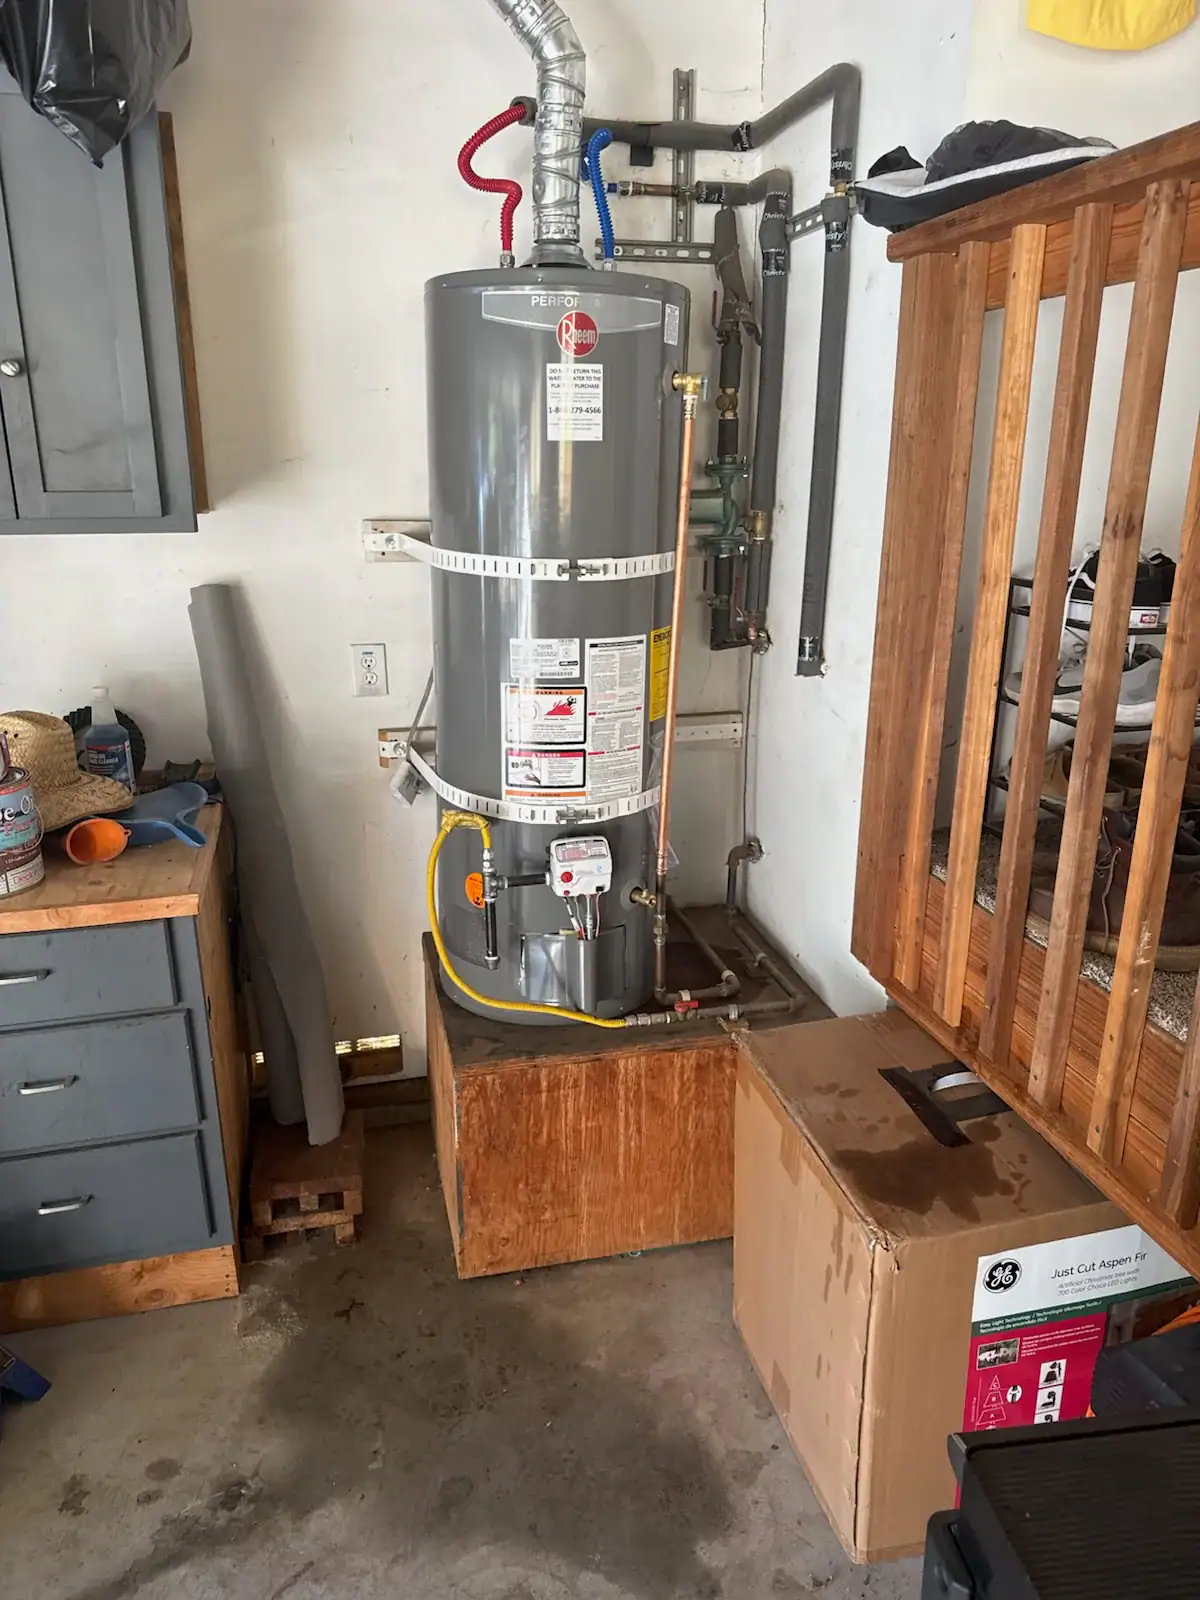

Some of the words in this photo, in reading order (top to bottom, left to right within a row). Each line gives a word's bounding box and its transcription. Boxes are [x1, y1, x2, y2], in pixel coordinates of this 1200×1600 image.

[561, 312, 597, 351] Rheem
[1051, 1267, 1073, 1279] Just
[1077, 1262, 1096, 1274] Cut
[1099, 1256, 1132, 1271] Aspen
[1134, 1251, 1148, 1262] Fir
[1071, 1286, 1087, 1294] Color
[1088, 1282, 1107, 1290] Choice
